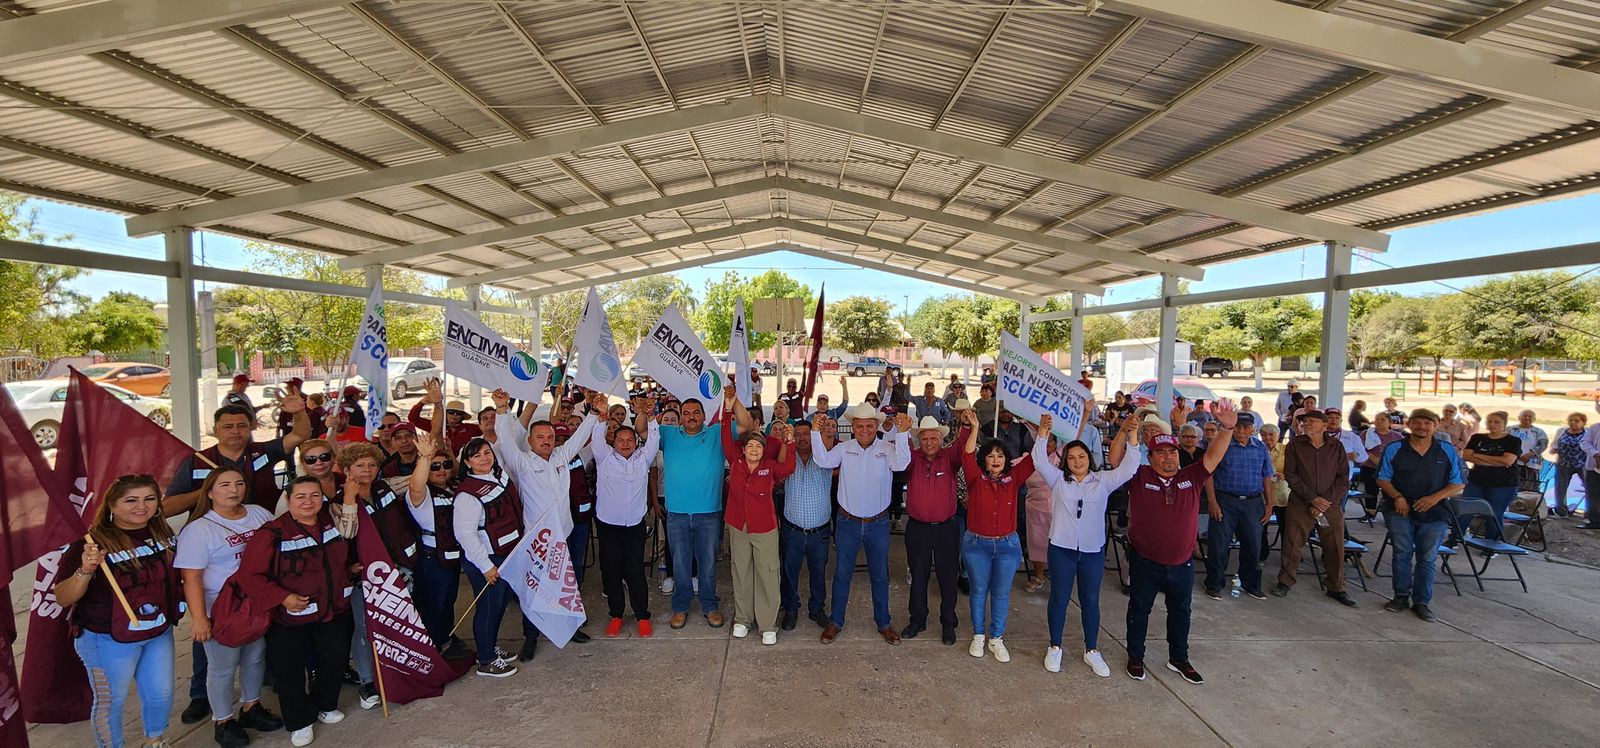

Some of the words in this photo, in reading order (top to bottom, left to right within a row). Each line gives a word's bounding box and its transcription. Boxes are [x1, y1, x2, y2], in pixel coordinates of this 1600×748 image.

[447, 320, 508, 363] ENCIMA
[653, 322, 704, 376] ENCIMA
[461, 351, 490, 368] GUASAVE
[659, 353, 685, 375] GUASAVE
[1003, 361, 1025, 379] ARA
